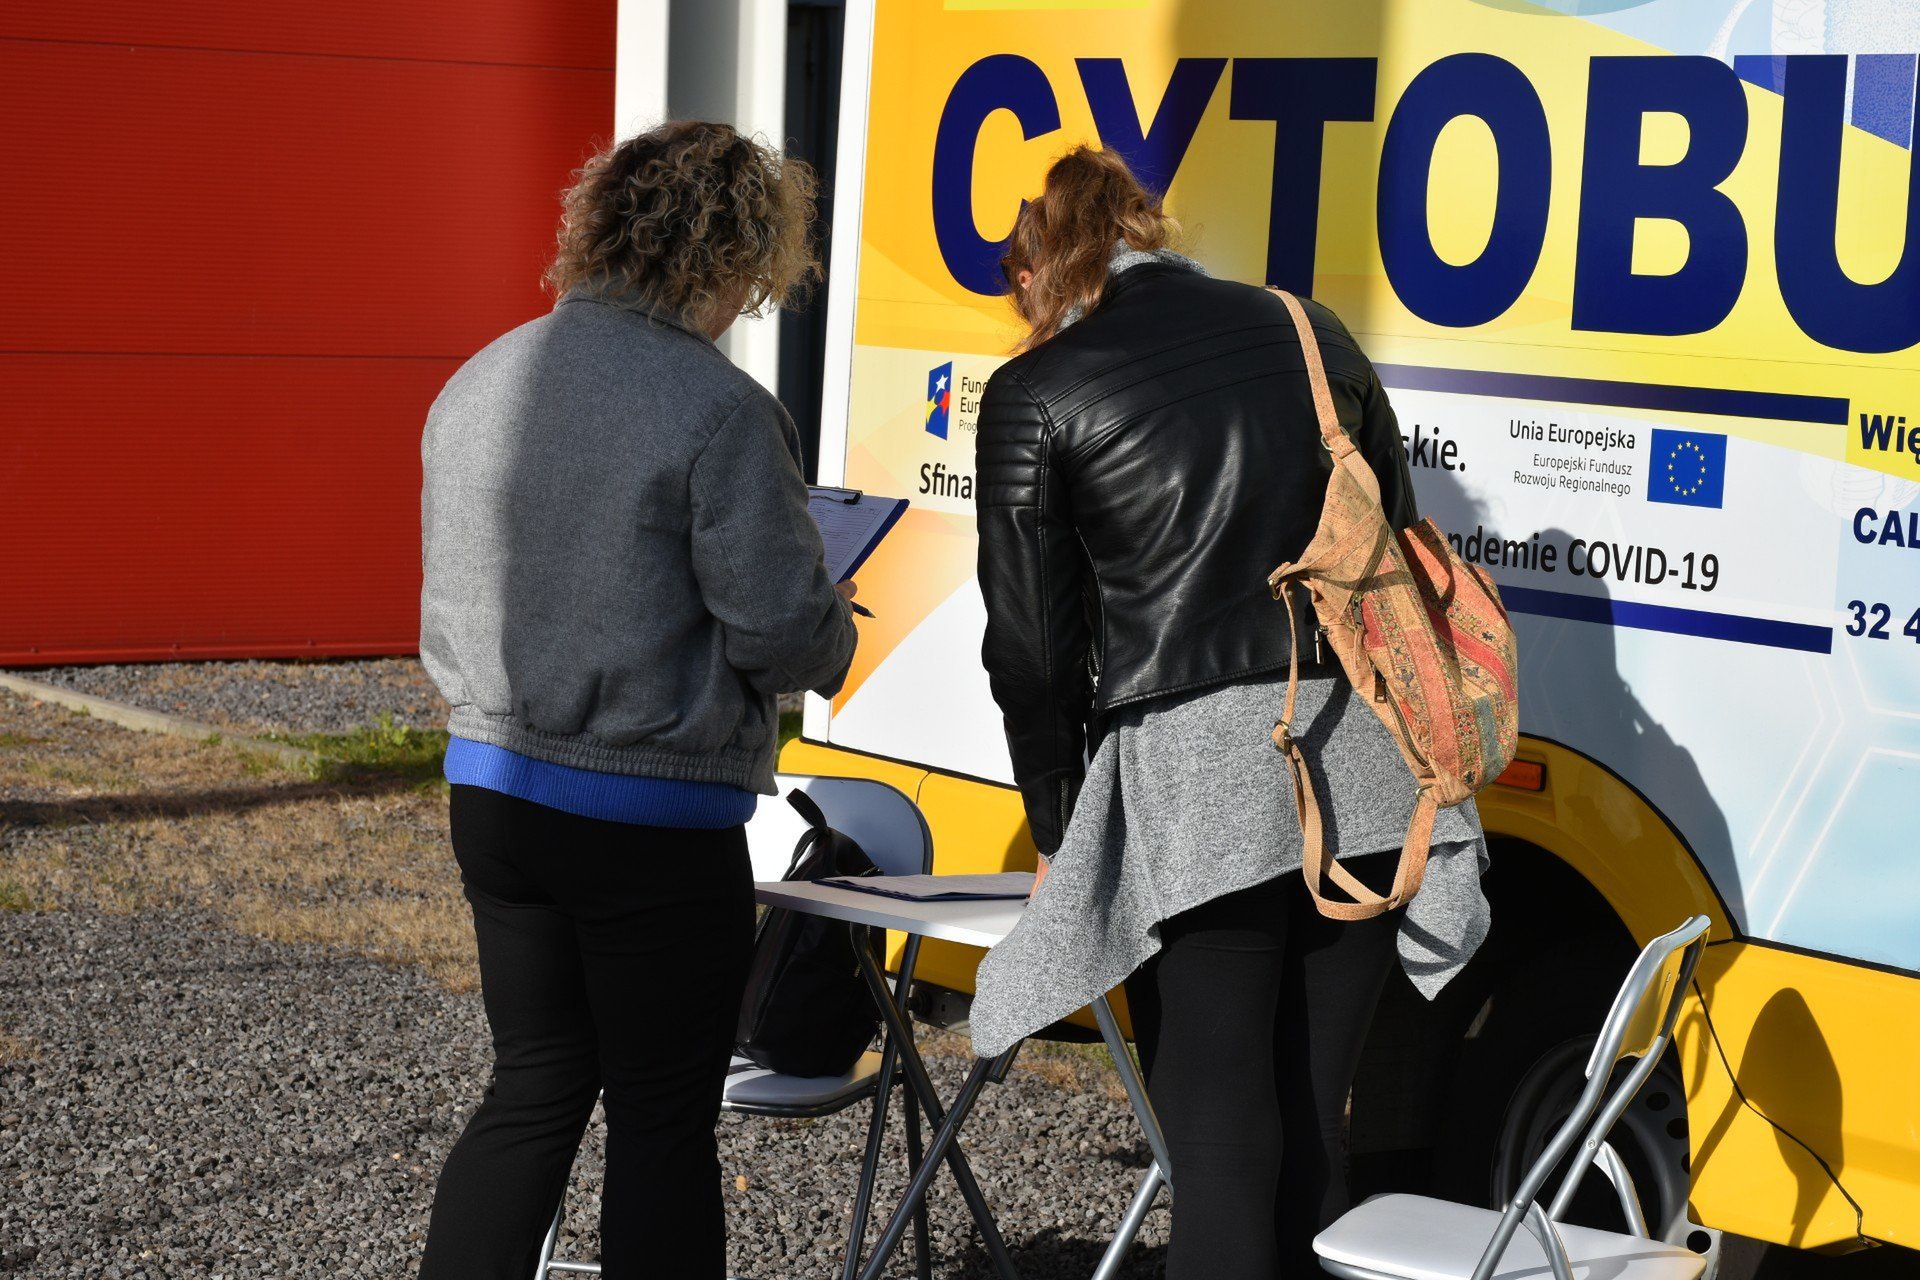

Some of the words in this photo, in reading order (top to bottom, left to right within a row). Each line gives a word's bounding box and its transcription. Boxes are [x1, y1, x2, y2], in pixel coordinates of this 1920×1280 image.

[960, 397, 980, 414] Eur
[959, 419, 977, 434] Prog
[1510, 419, 1544, 441] Unia
[1548, 423, 1636, 451] Europejska
[1533, 453, 1587, 473] Europejski
[1589, 458, 1633, 476] Fundusz
[918, 463, 972, 499] Sfina
[1513, 470, 1557, 490] Rozwoju
[1559, 475, 1632, 497] Regionalnego
[1853, 507, 1920, 549] CAL
[1567, 538, 1719, 592] COVID-19
[1845, 600, 1890, 640] 32
